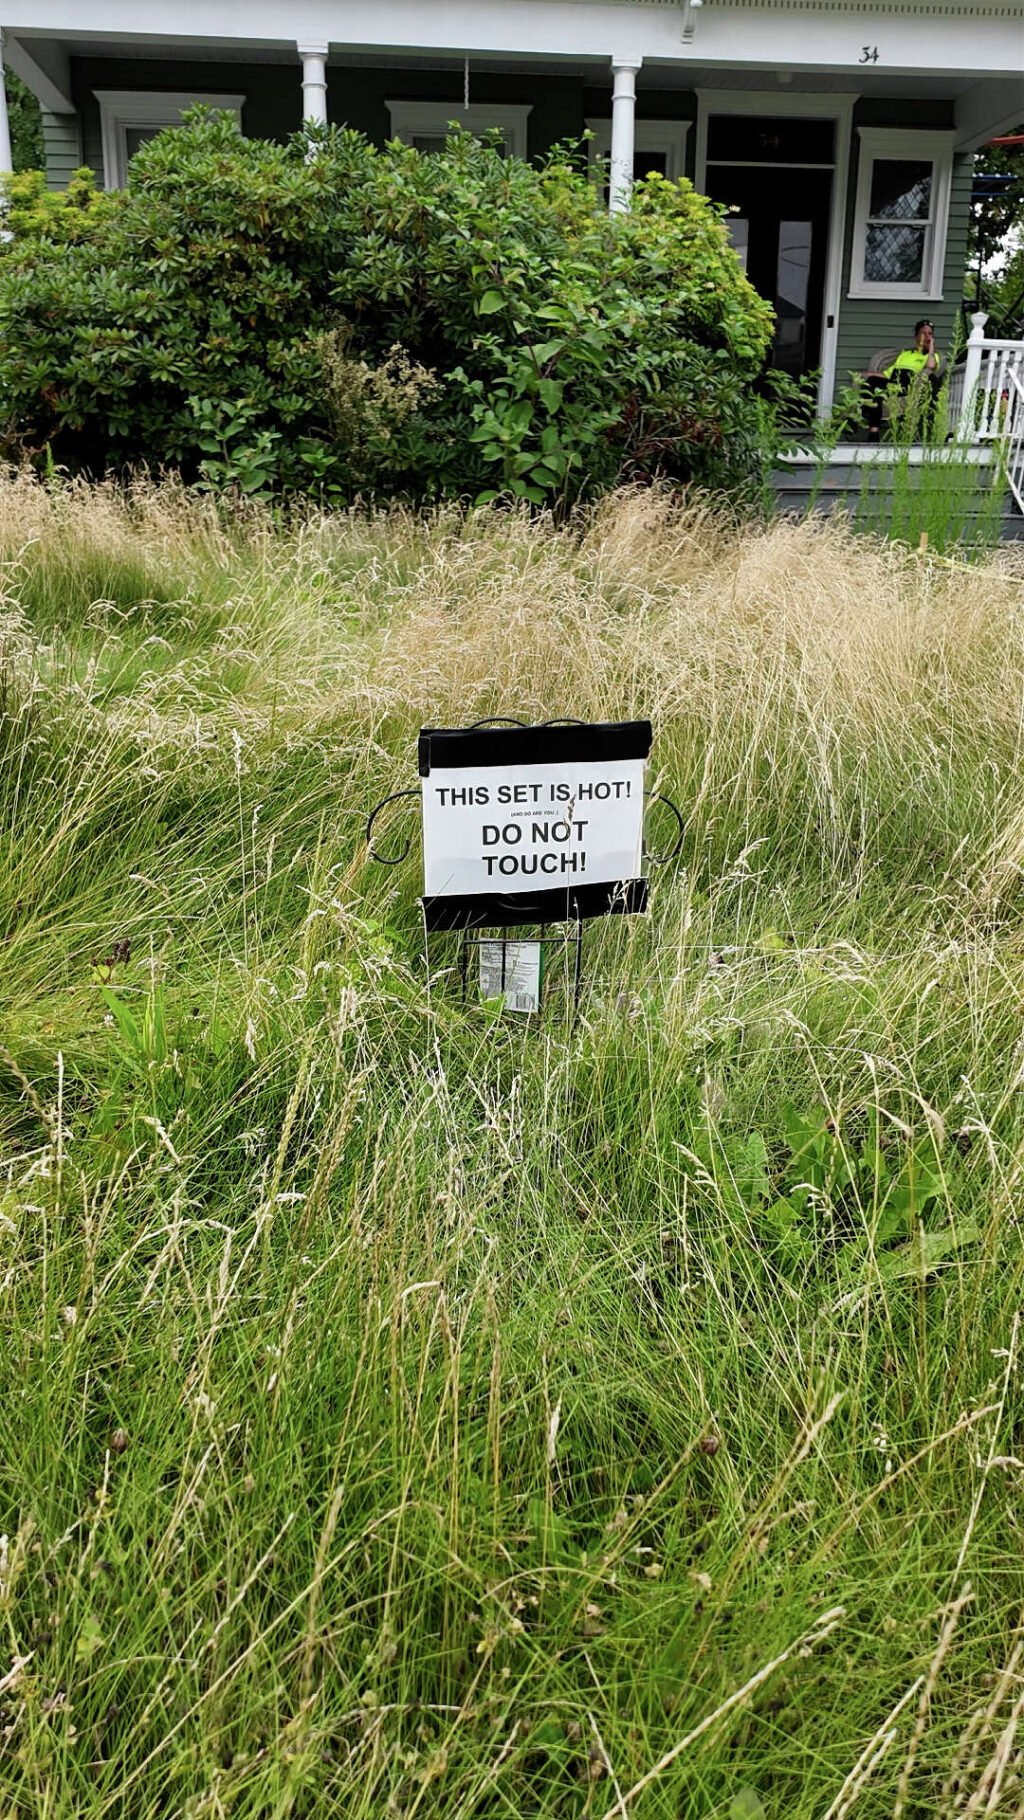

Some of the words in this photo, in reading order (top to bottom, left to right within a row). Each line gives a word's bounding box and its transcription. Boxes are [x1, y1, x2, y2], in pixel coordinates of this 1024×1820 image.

[858, 46, 879, 64] 34
[435, 786, 490, 807] THIS
[497, 784, 543, 804] SET
[550, 783, 571, 802] IS
[578, 780, 631, 800] HOT!
[482, 823, 522, 846] DO
[532, 820, 588, 844] NOT
[482, 851, 586, 876] TOUCH!
